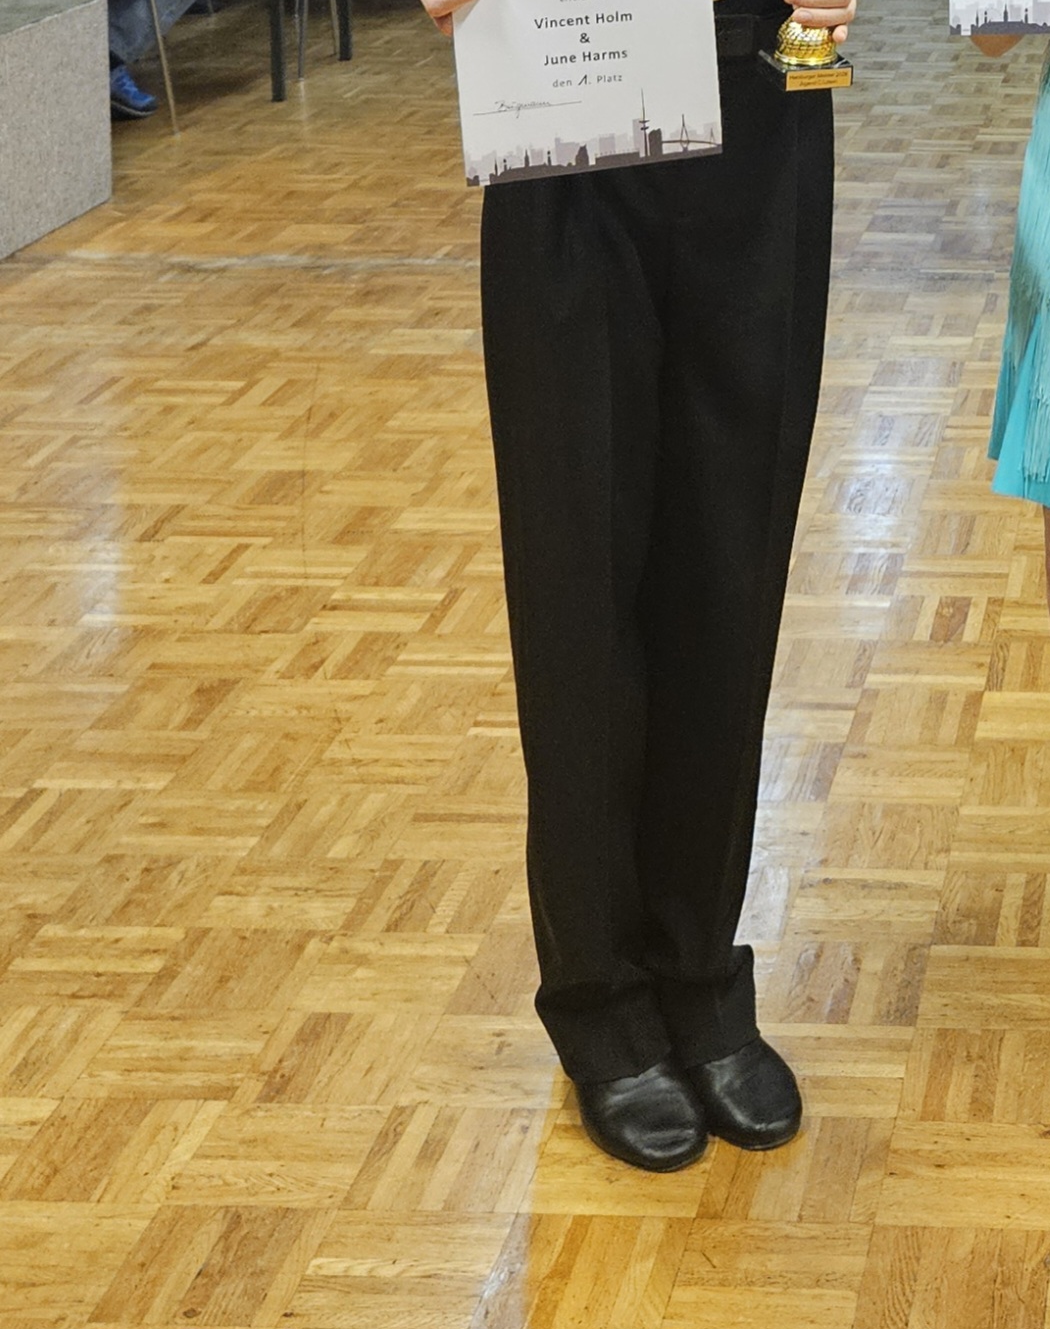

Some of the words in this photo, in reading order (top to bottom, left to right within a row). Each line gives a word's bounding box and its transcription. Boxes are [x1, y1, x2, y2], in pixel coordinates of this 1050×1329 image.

[534, 14, 590, 30] Vincent
[595, 11, 633, 24] Holm
[579, 32, 591, 44] &
[544, 54, 577, 66] June
[582, 49, 628, 62] Harms
[552, 78, 573, 88] den
[596, 74, 623, 84] Platz
